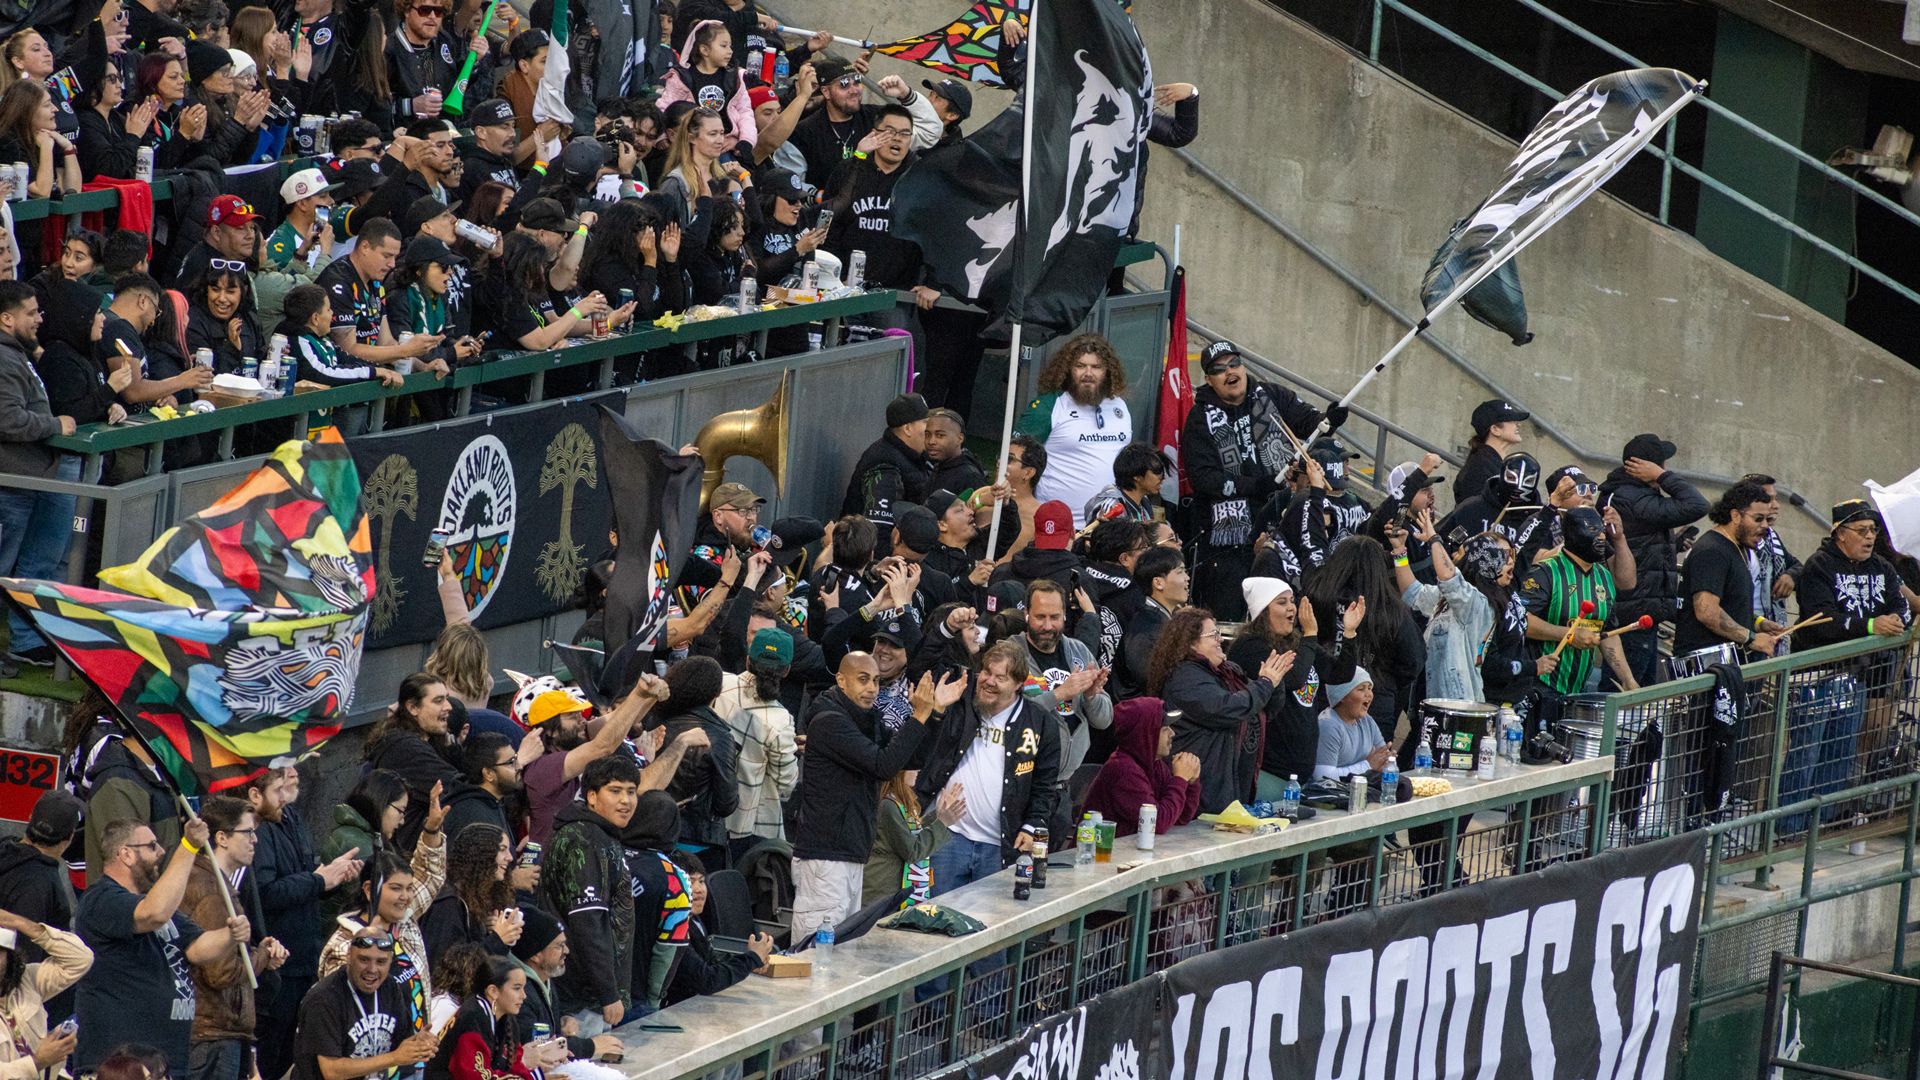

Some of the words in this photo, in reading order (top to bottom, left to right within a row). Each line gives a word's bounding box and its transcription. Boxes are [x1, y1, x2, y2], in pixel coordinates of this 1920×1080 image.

[852, 196, 891, 215] OAKLA
[859, 216, 889, 232] ROOT
[338, 314, 355, 322] OAK
[1078, 433, 1117, 442] Anthem
[444, 445, 490, 535] OAKLAND
[489, 447, 513, 526] ROOTS
[74, 517, 85, 532] 21
[0, 753, 54, 791] 132
[393, 966, 418, 984] Anthe
[1172, 965, 1303, 1080] LOS
[1314, 899, 1577, 1080] ROOTS
[347, 1013, 397, 1044] FOREVER
